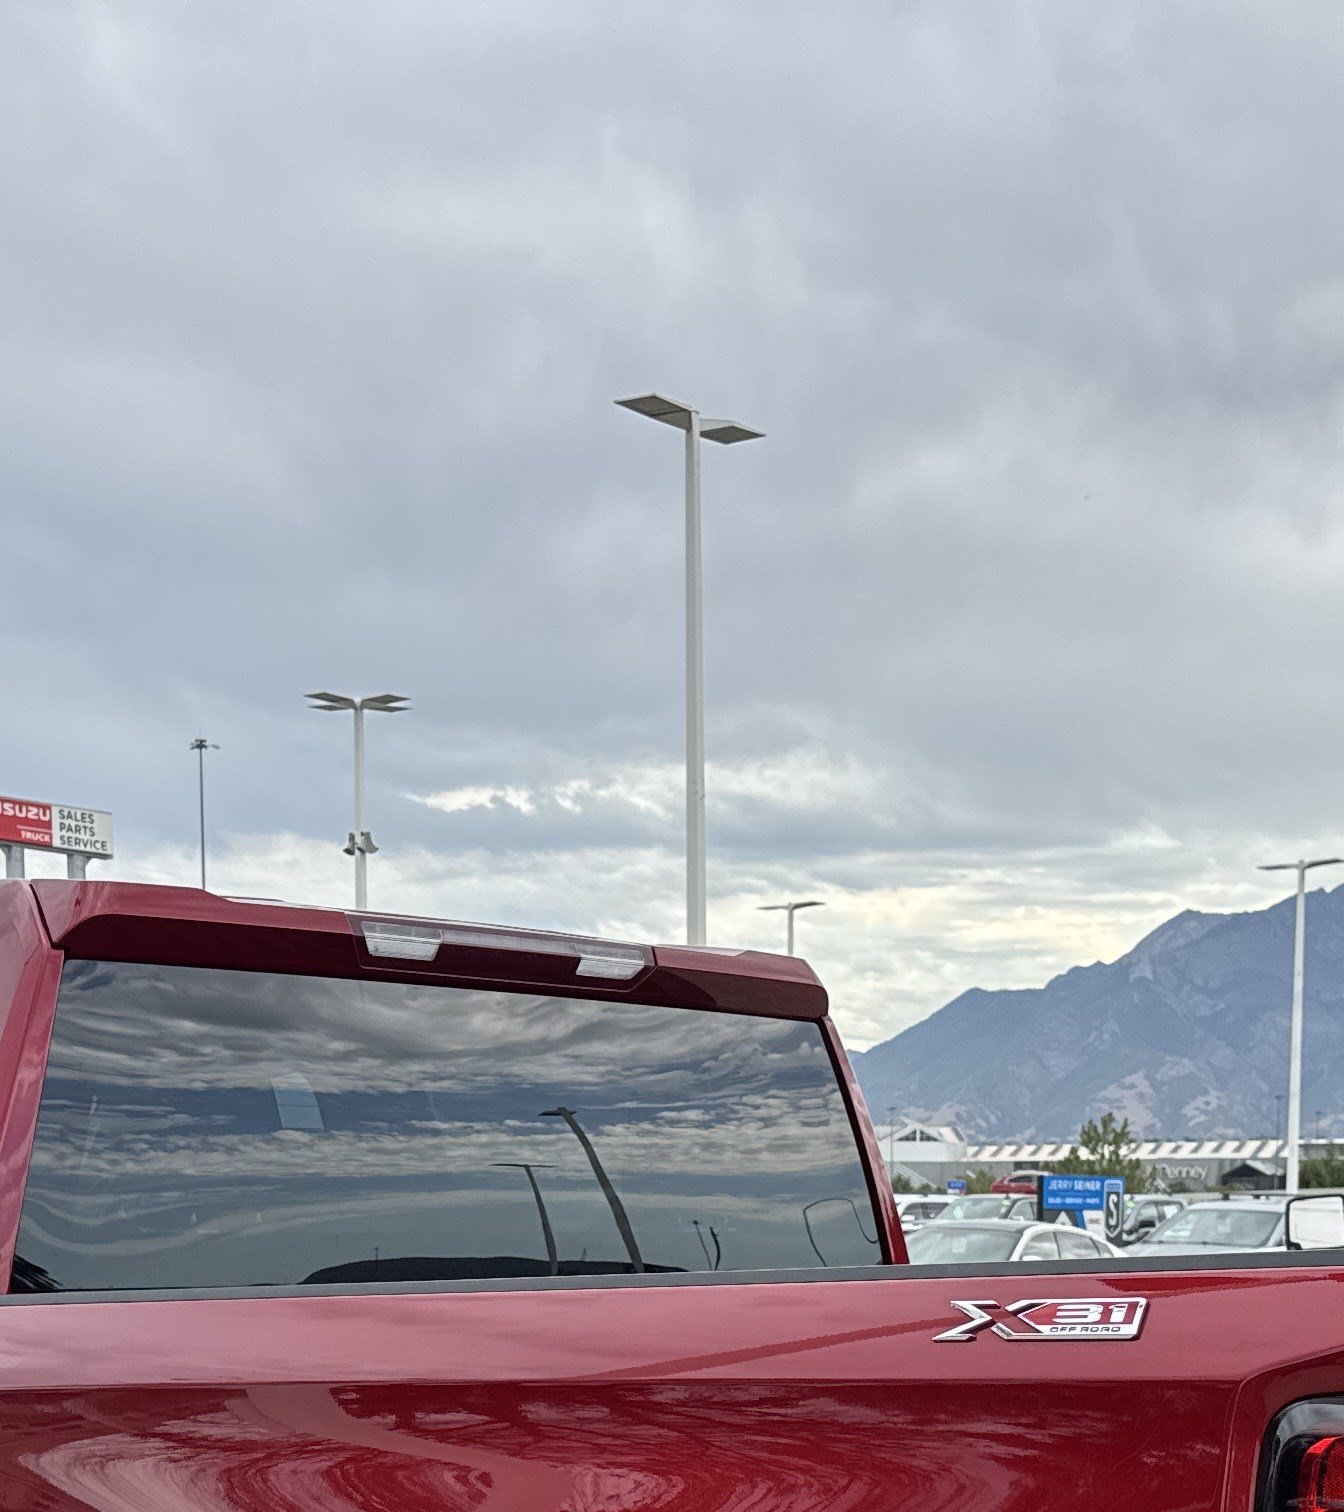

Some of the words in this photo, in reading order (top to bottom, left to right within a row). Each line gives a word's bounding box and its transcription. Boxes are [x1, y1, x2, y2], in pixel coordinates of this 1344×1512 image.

[58, 808, 95, 825] SALES
[20, 830, 50, 842] TRUCK
[59, 822, 96, 837] PARTS
[59, 835, 108, 851] SERVICE
[932, 1298, 1149, 1342] X31
